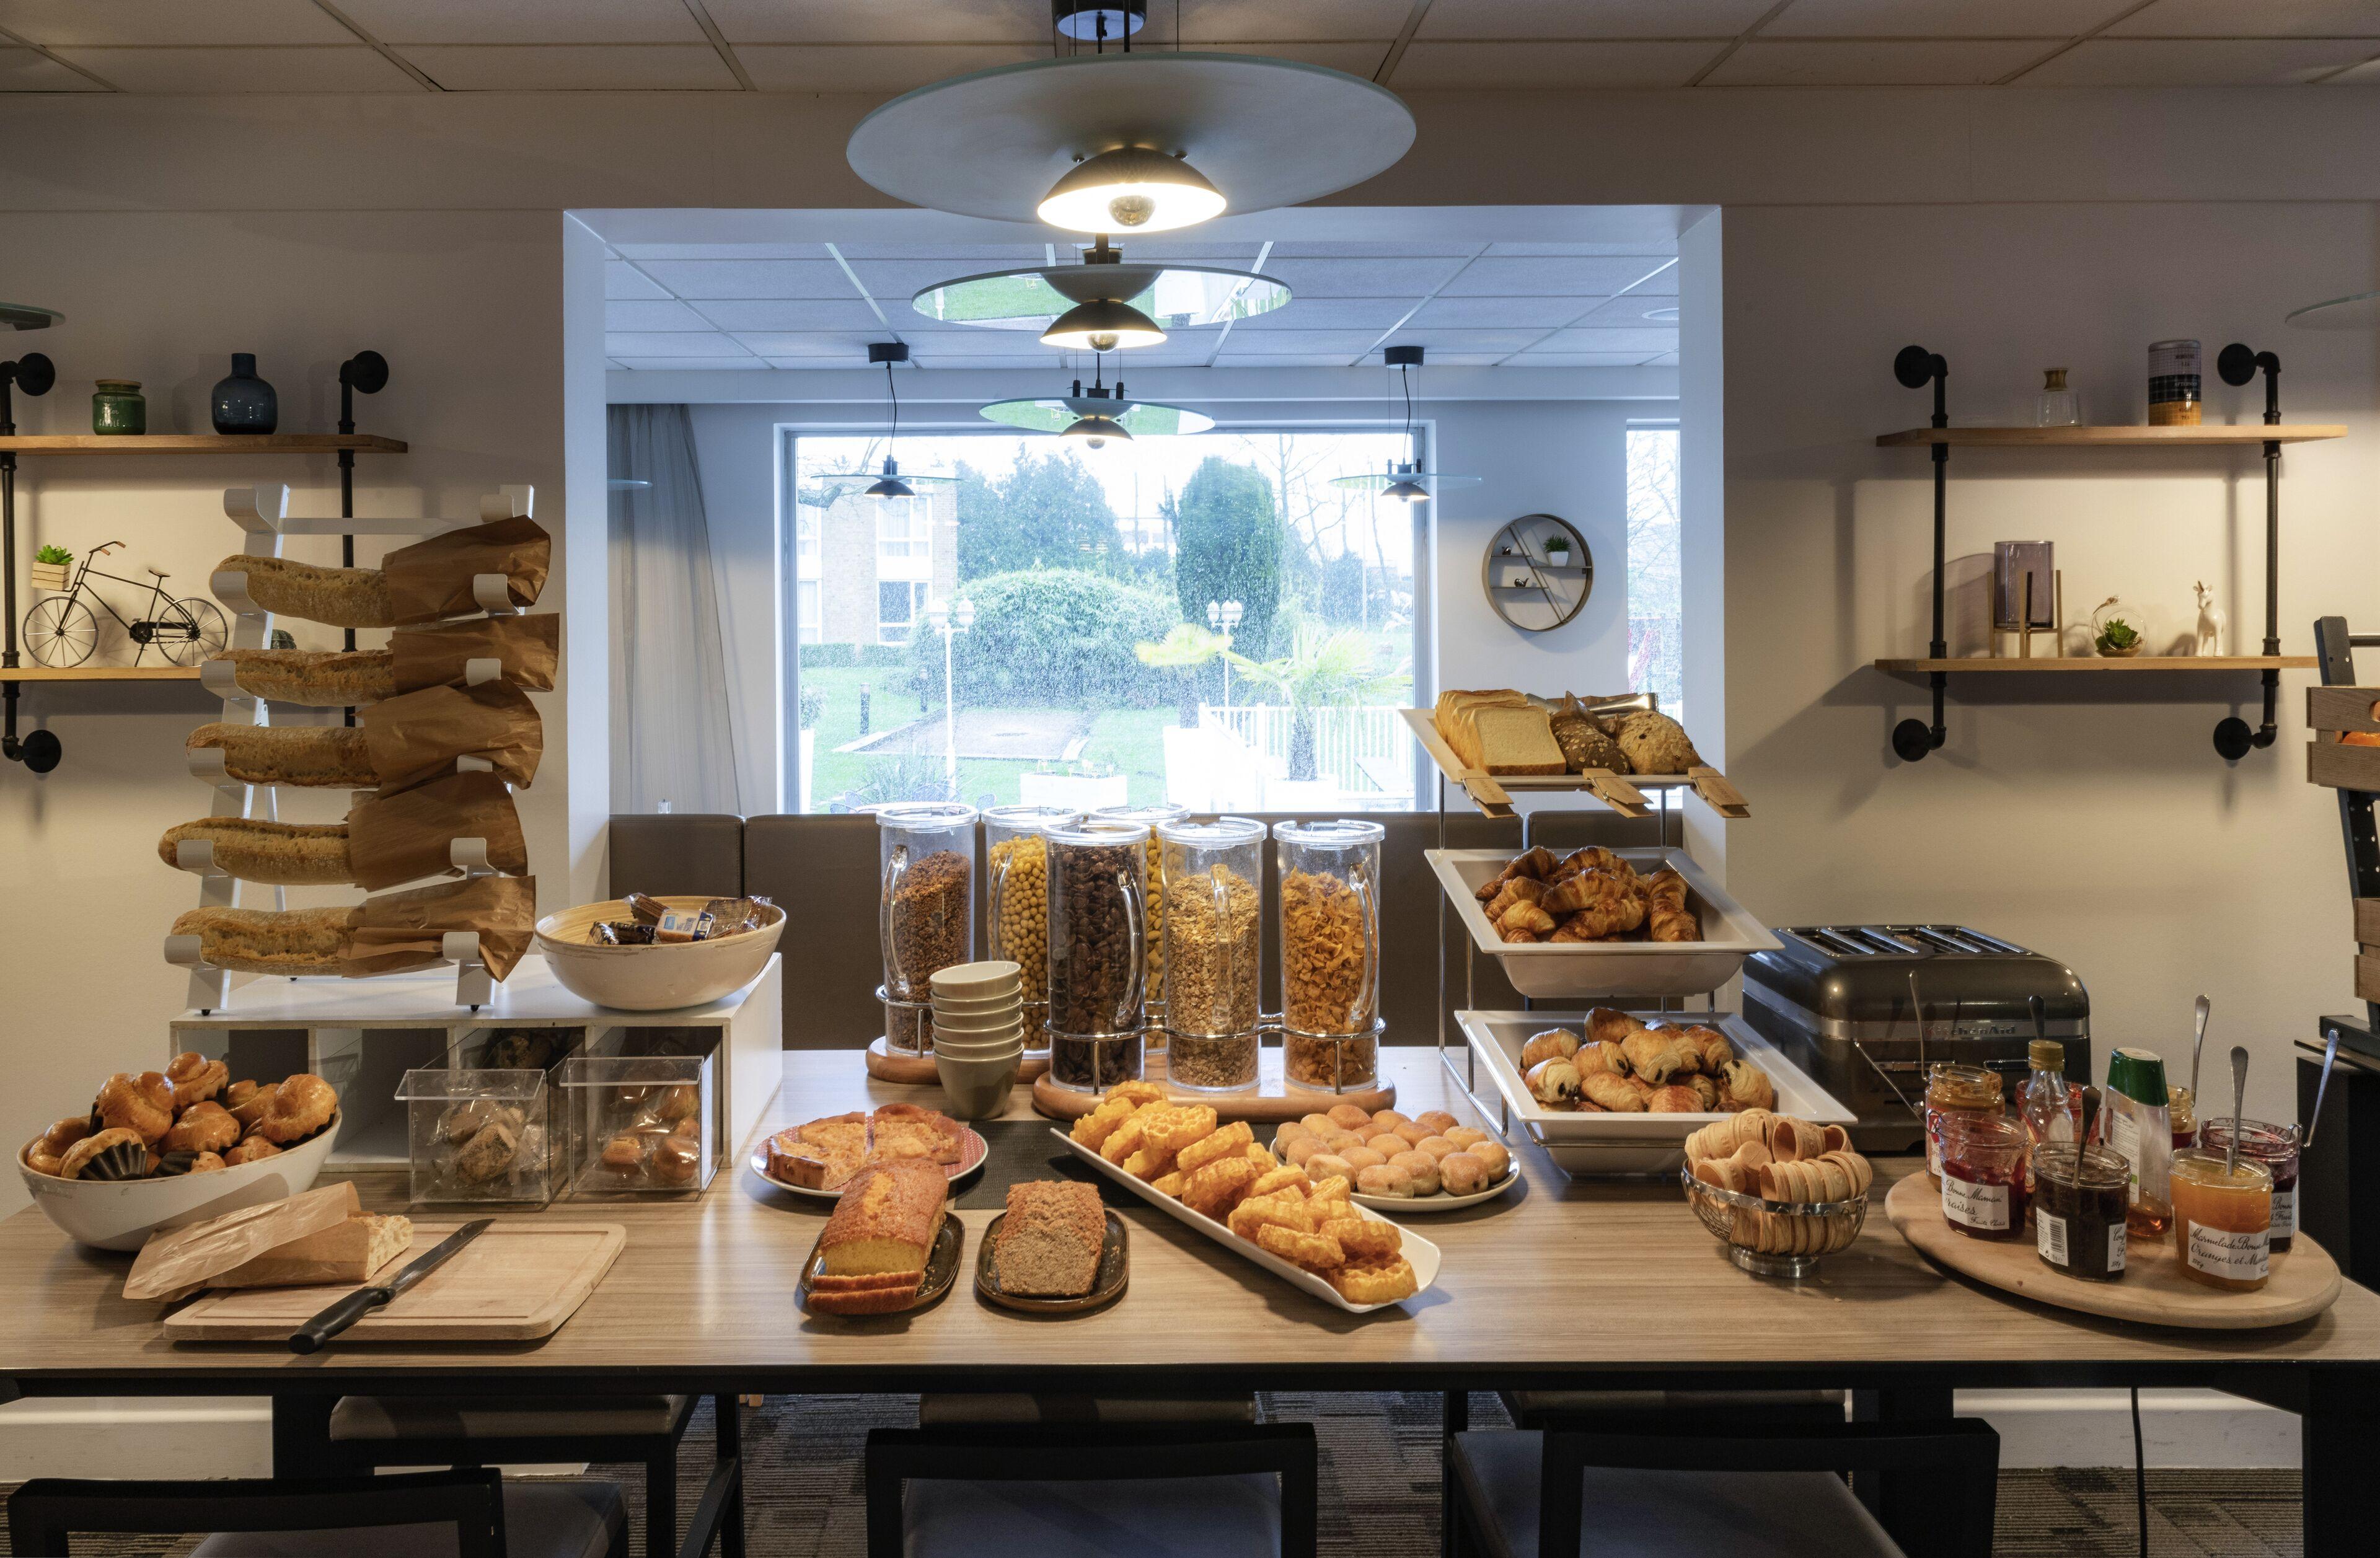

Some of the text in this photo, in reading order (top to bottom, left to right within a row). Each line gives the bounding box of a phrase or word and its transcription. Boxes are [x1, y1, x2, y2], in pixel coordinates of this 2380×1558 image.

[1924, 1025, 2015, 1036] KitchenAid
[1946, 1179, 2002, 1203] Bonne Maman
[2190, 1228, 2236, 1249] Marmelade
[2191, 1243, 2231, 1264] Oranges
[2234, 1256, 2242, 1265] et
